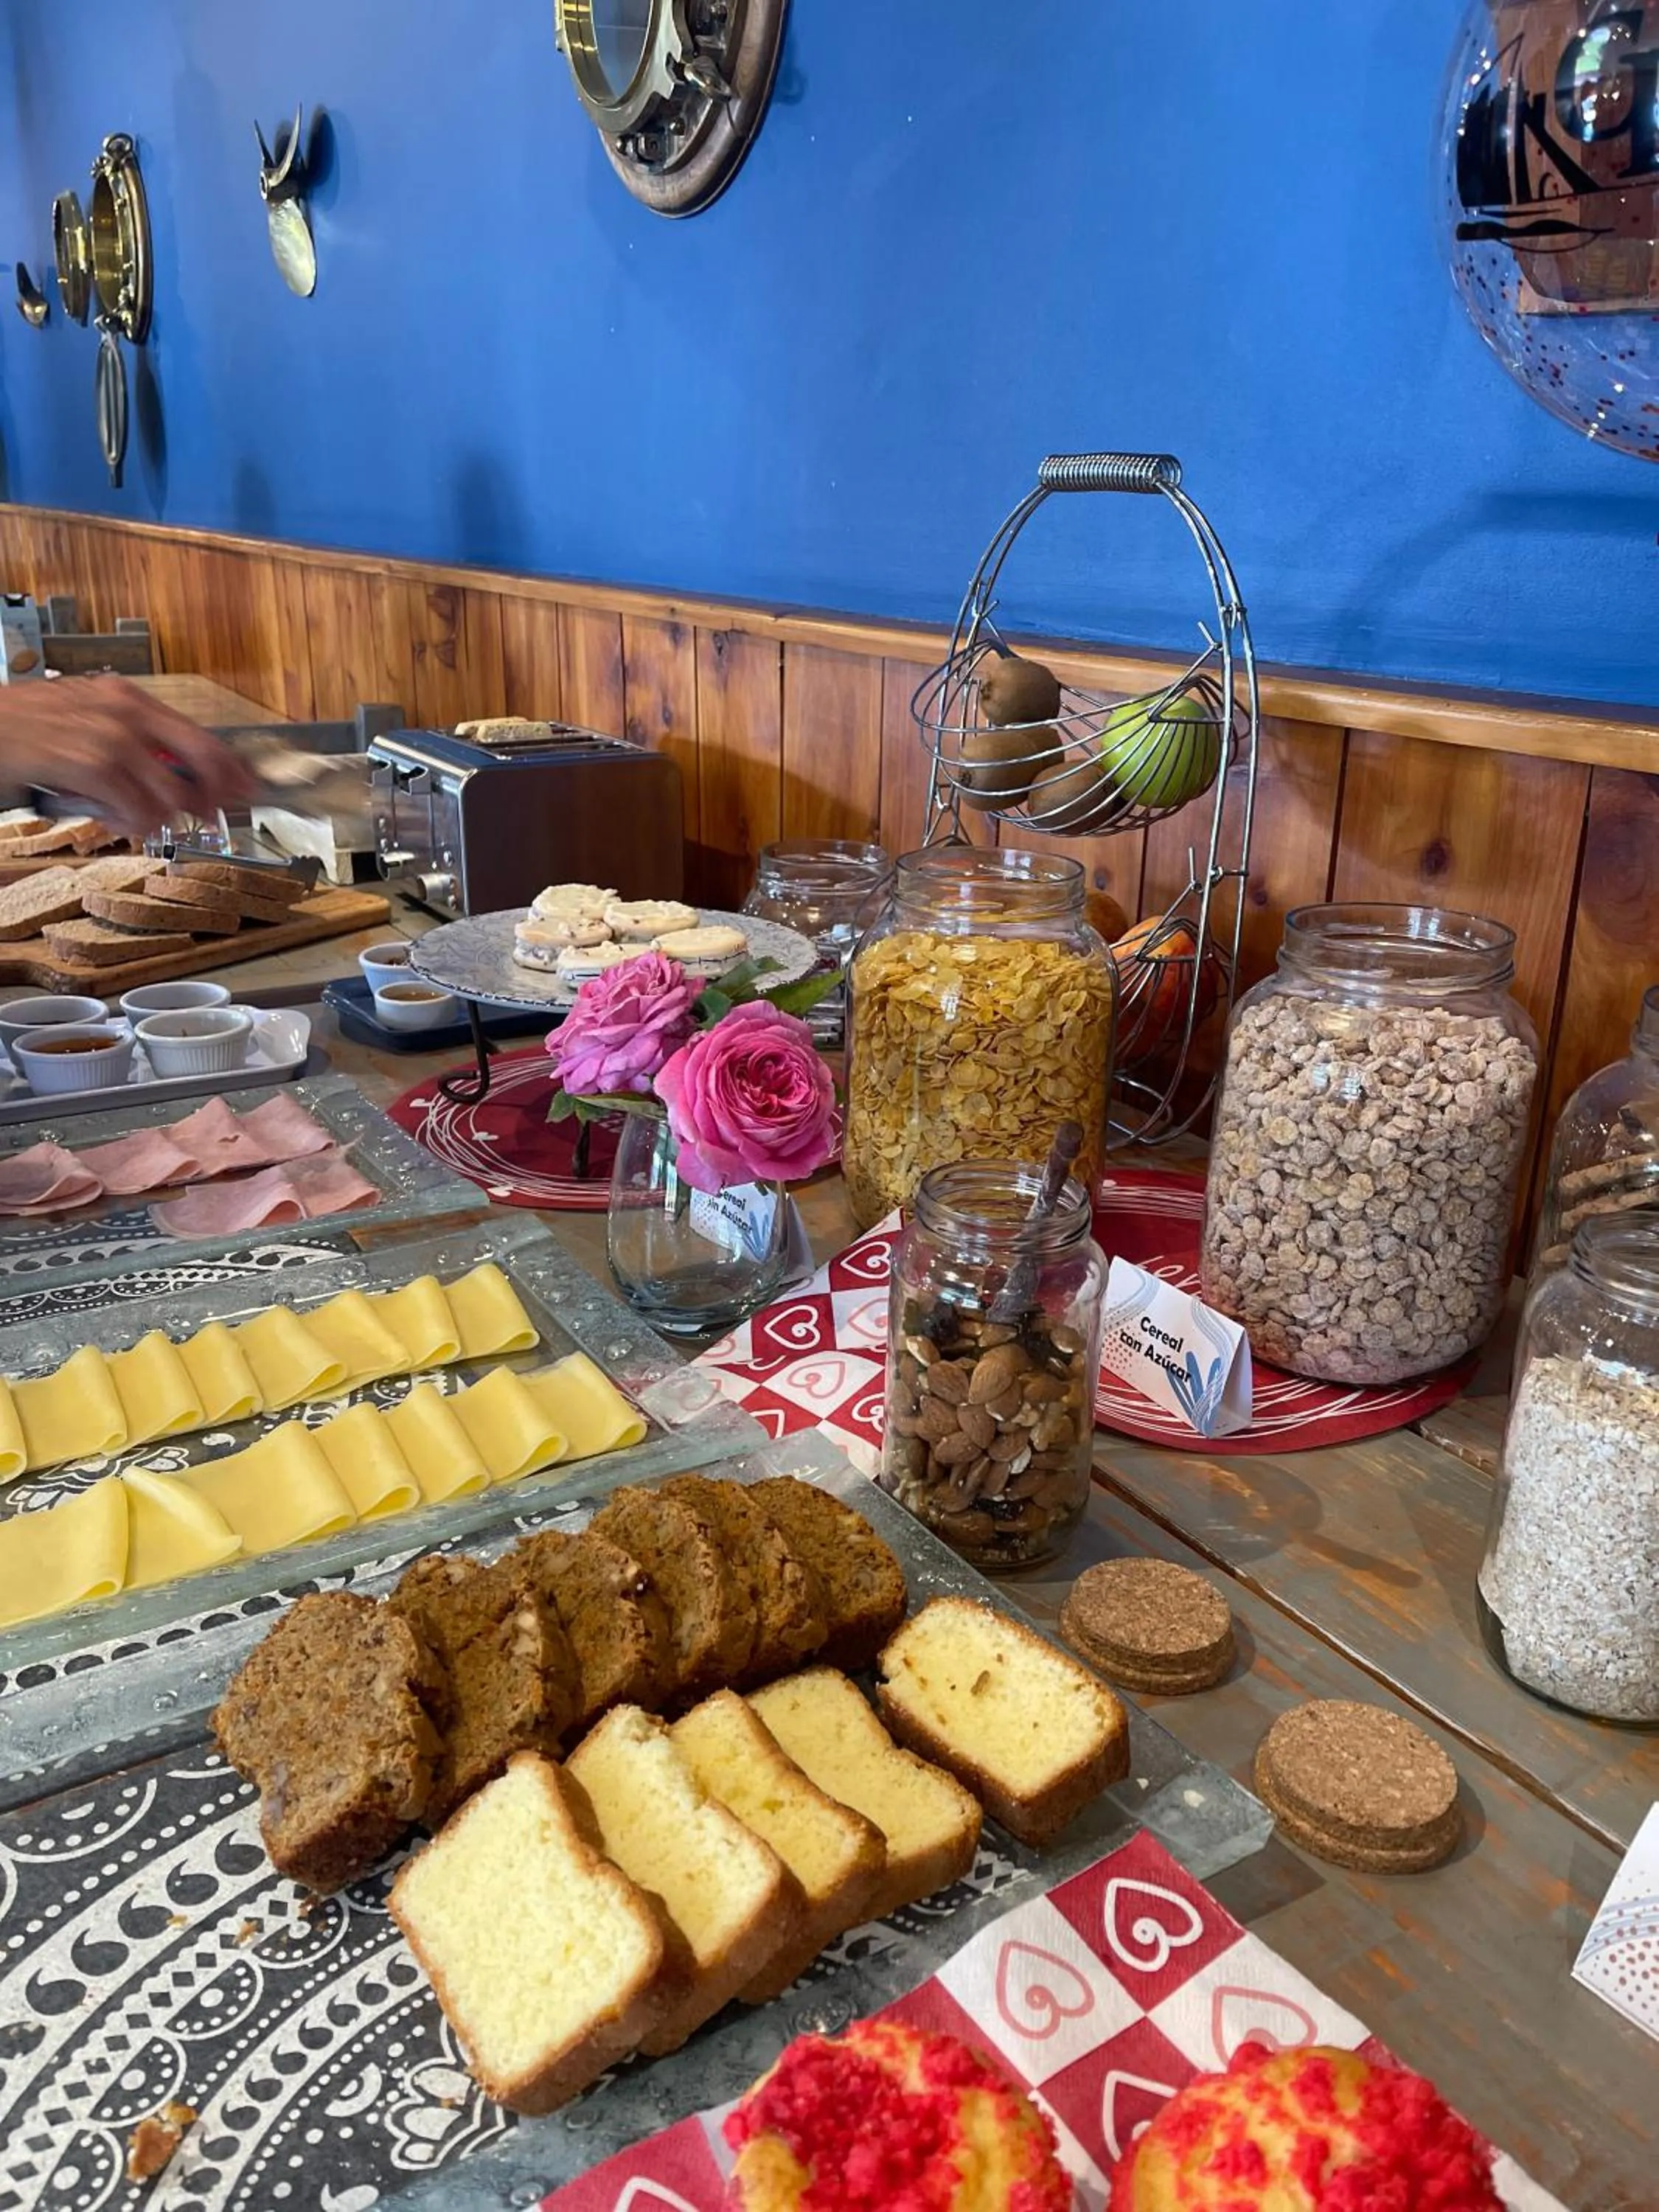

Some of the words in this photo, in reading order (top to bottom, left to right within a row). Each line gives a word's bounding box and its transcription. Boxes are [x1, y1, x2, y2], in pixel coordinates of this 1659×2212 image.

[1120, 1331, 1142, 1353] con
[1144, 1344, 1192, 1382] Azúcar
[1140, 1316, 1184, 1353] Cereal
